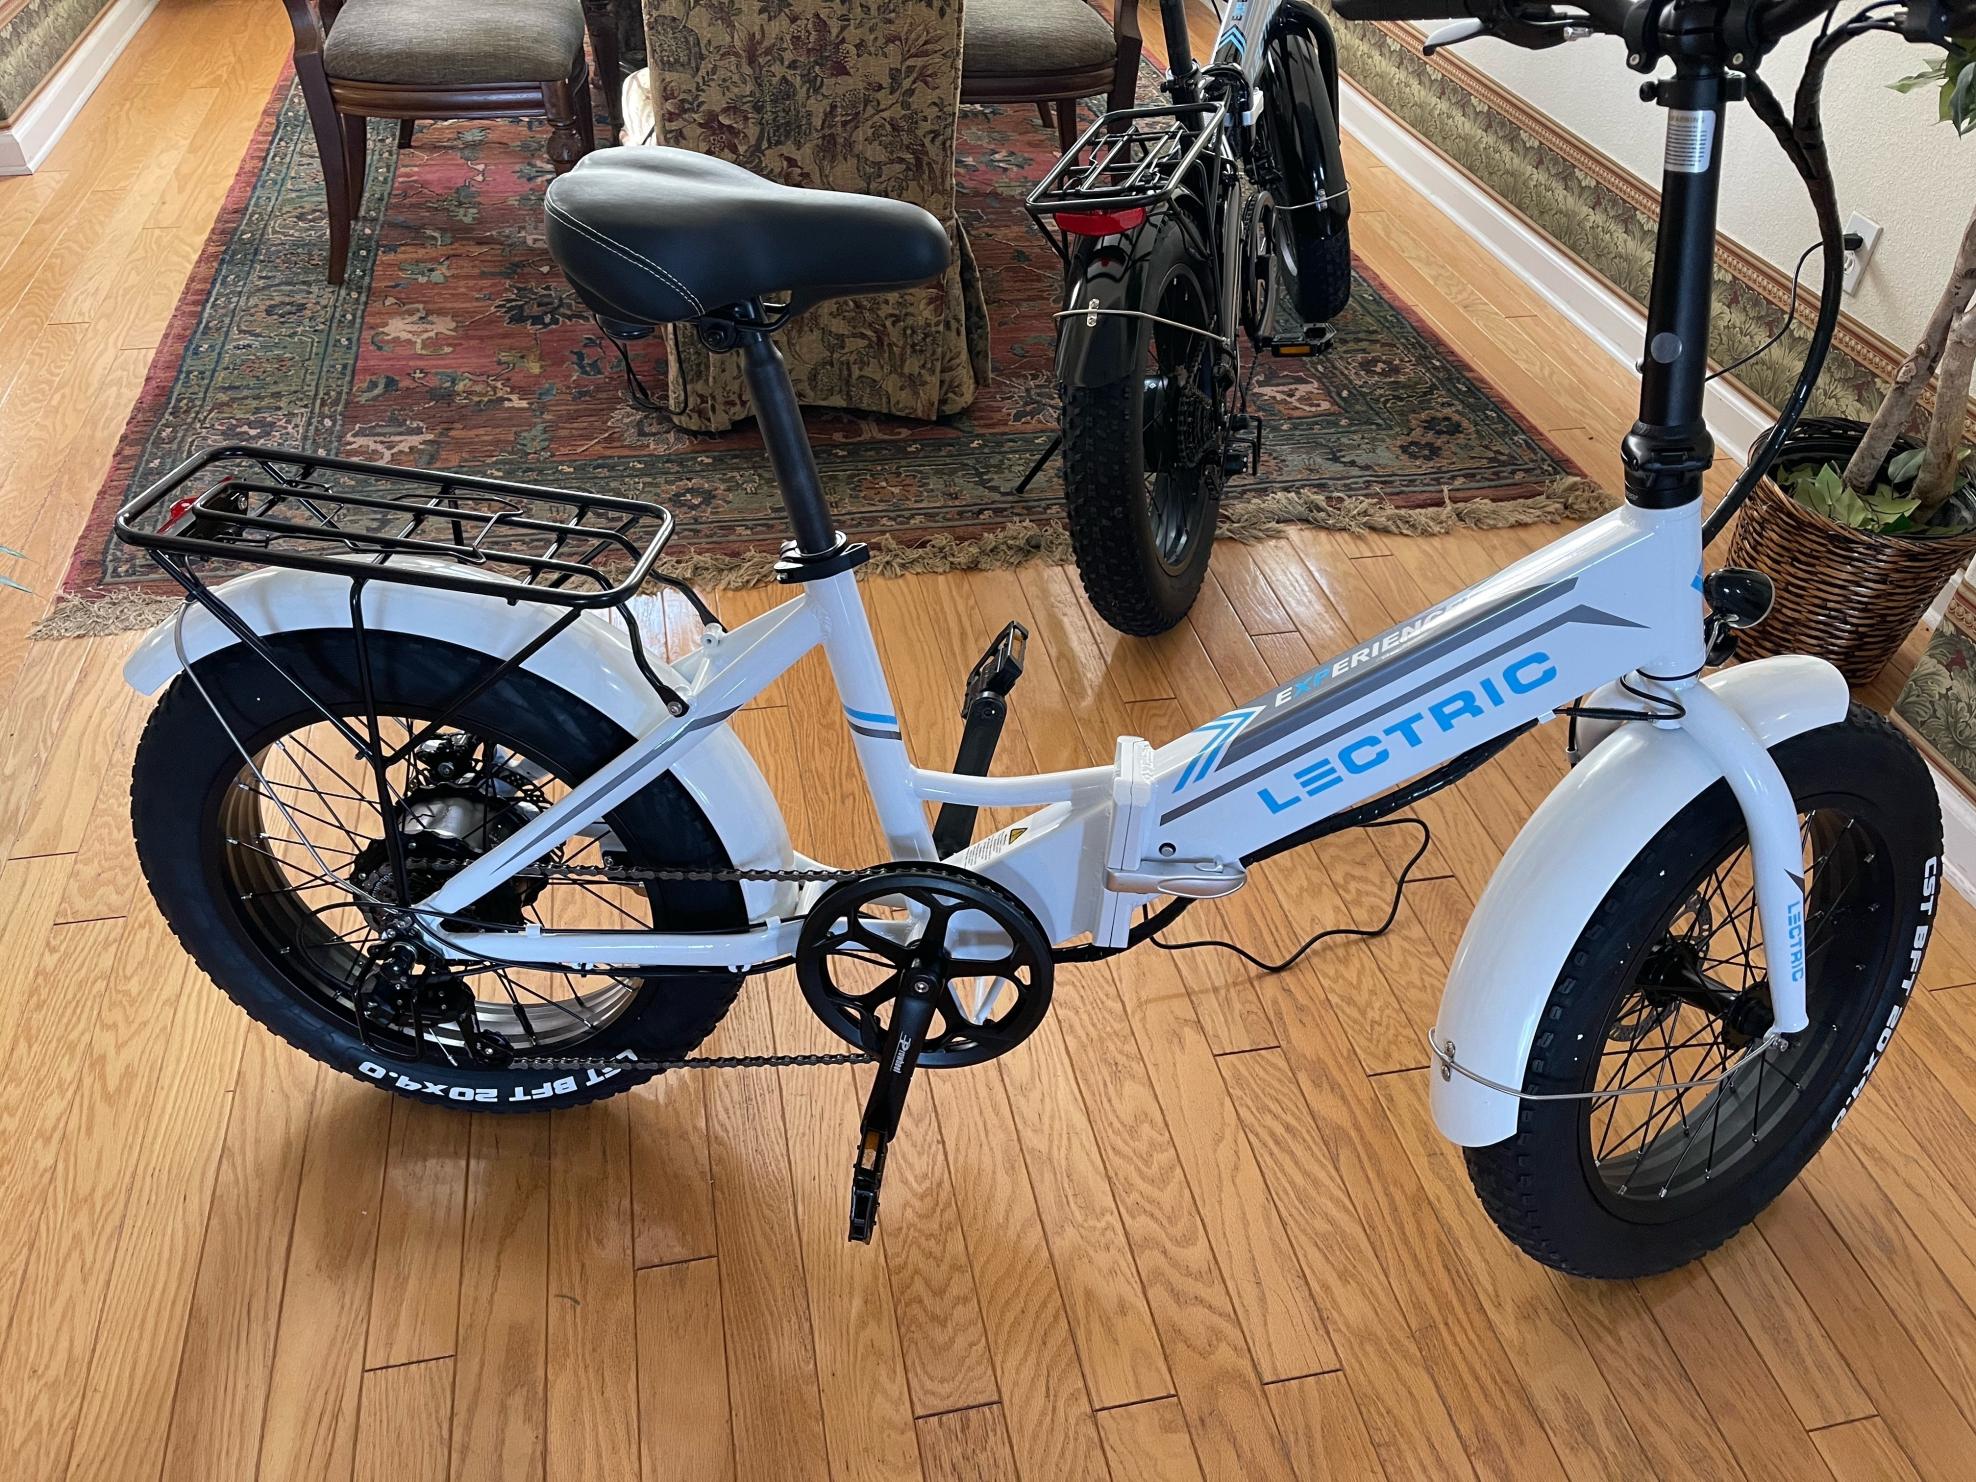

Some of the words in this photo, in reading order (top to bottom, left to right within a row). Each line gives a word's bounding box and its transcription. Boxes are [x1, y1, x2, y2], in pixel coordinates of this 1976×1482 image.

[1257, 651, 1557, 815] LECTRIC
[1919, 855, 1938, 916] CST
[1788, 900, 1804, 982] LECTRIC
[1901, 925, 1929, 996] BFT
[509, 1075, 578, 1102] BFT
